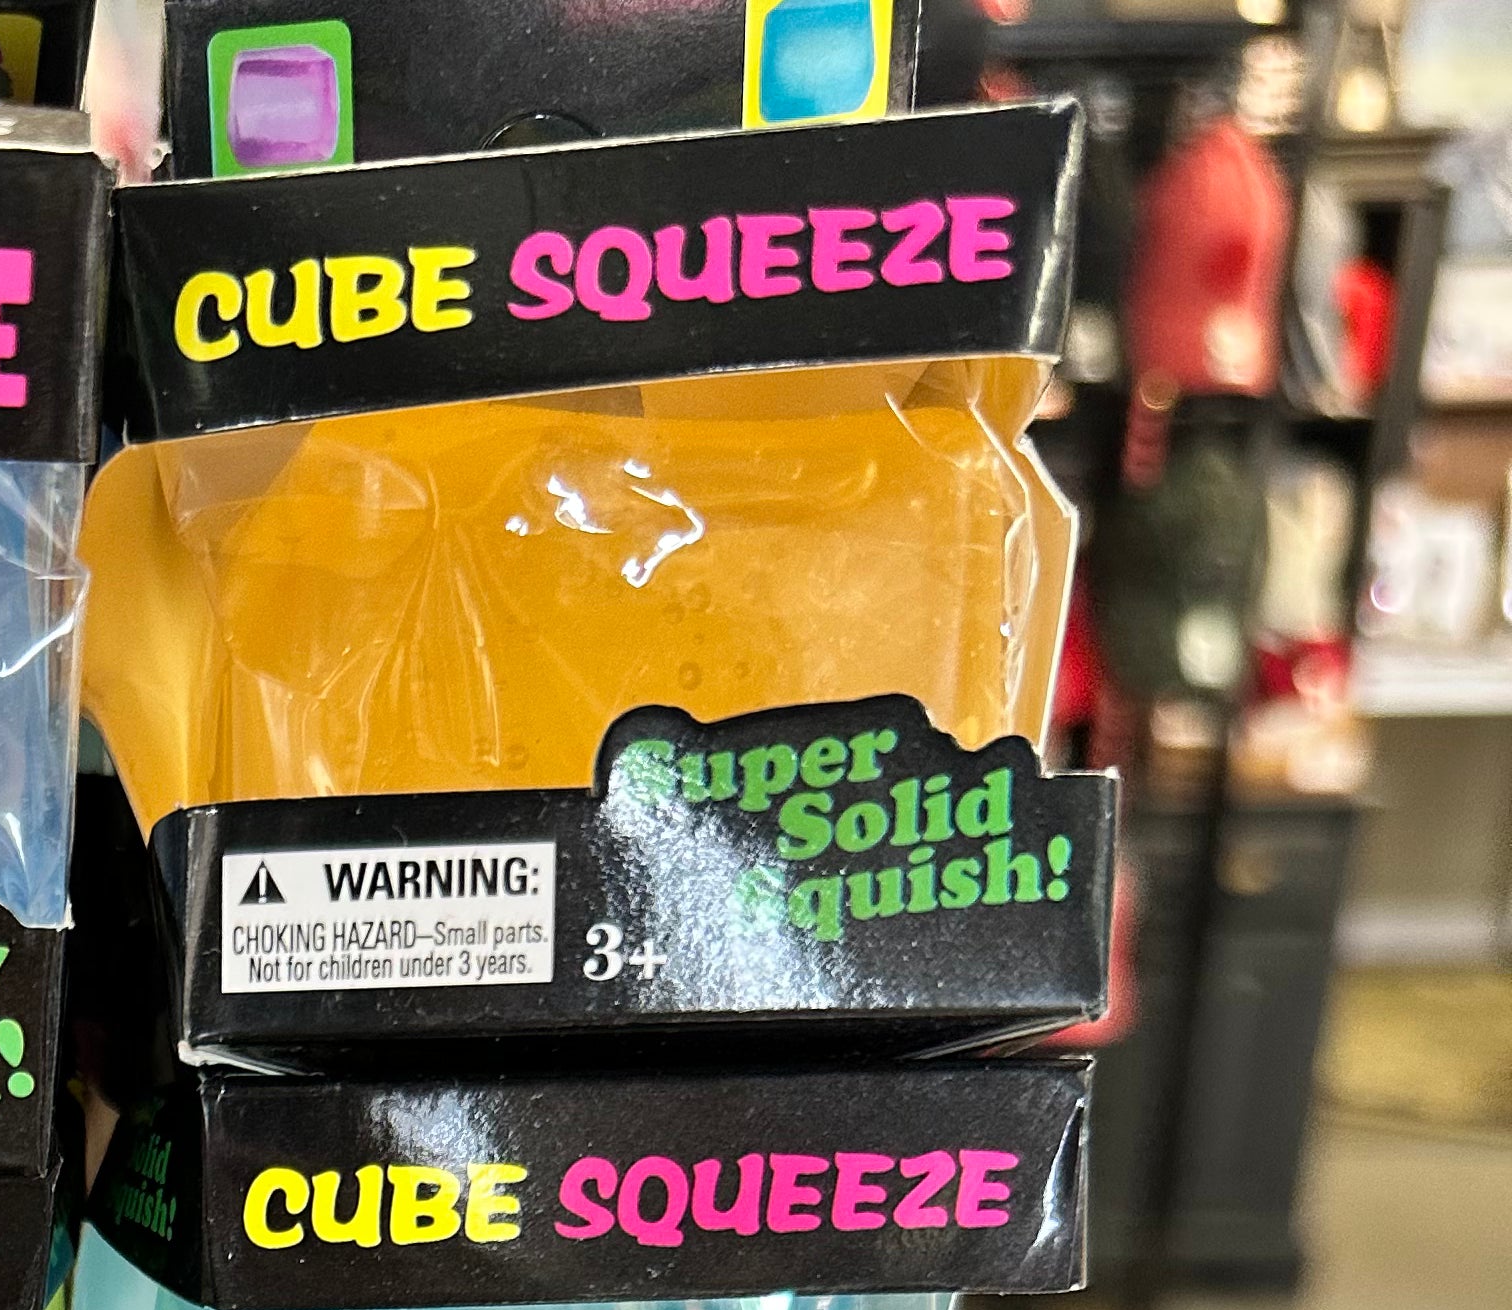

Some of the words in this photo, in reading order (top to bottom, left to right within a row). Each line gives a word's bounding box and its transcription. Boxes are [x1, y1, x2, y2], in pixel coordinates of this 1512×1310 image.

[175, 246, 473, 362] CUBE
[506, 196, 1017, 322] SQUEEZE
[610, 727, 899, 813] Super
[776, 766, 1015, 862] Solid
[324, 857, 539, 901] WARNING:
[233, 922, 325, 954] CHOKING
[492, 921, 549, 949] parts.
[248, 956, 281, 983] Not
[287, 956, 313, 981] for
[319, 953, 393, 981] children
[399, 952, 452, 978] under
[458, 950, 470, 976] 3
[475, 953, 533, 980] years.
[584, 921, 670, 983] 3+
[243, 1162, 528, 1250] CUBE
[554, 1149, 1020, 1248] SQUEEZE
